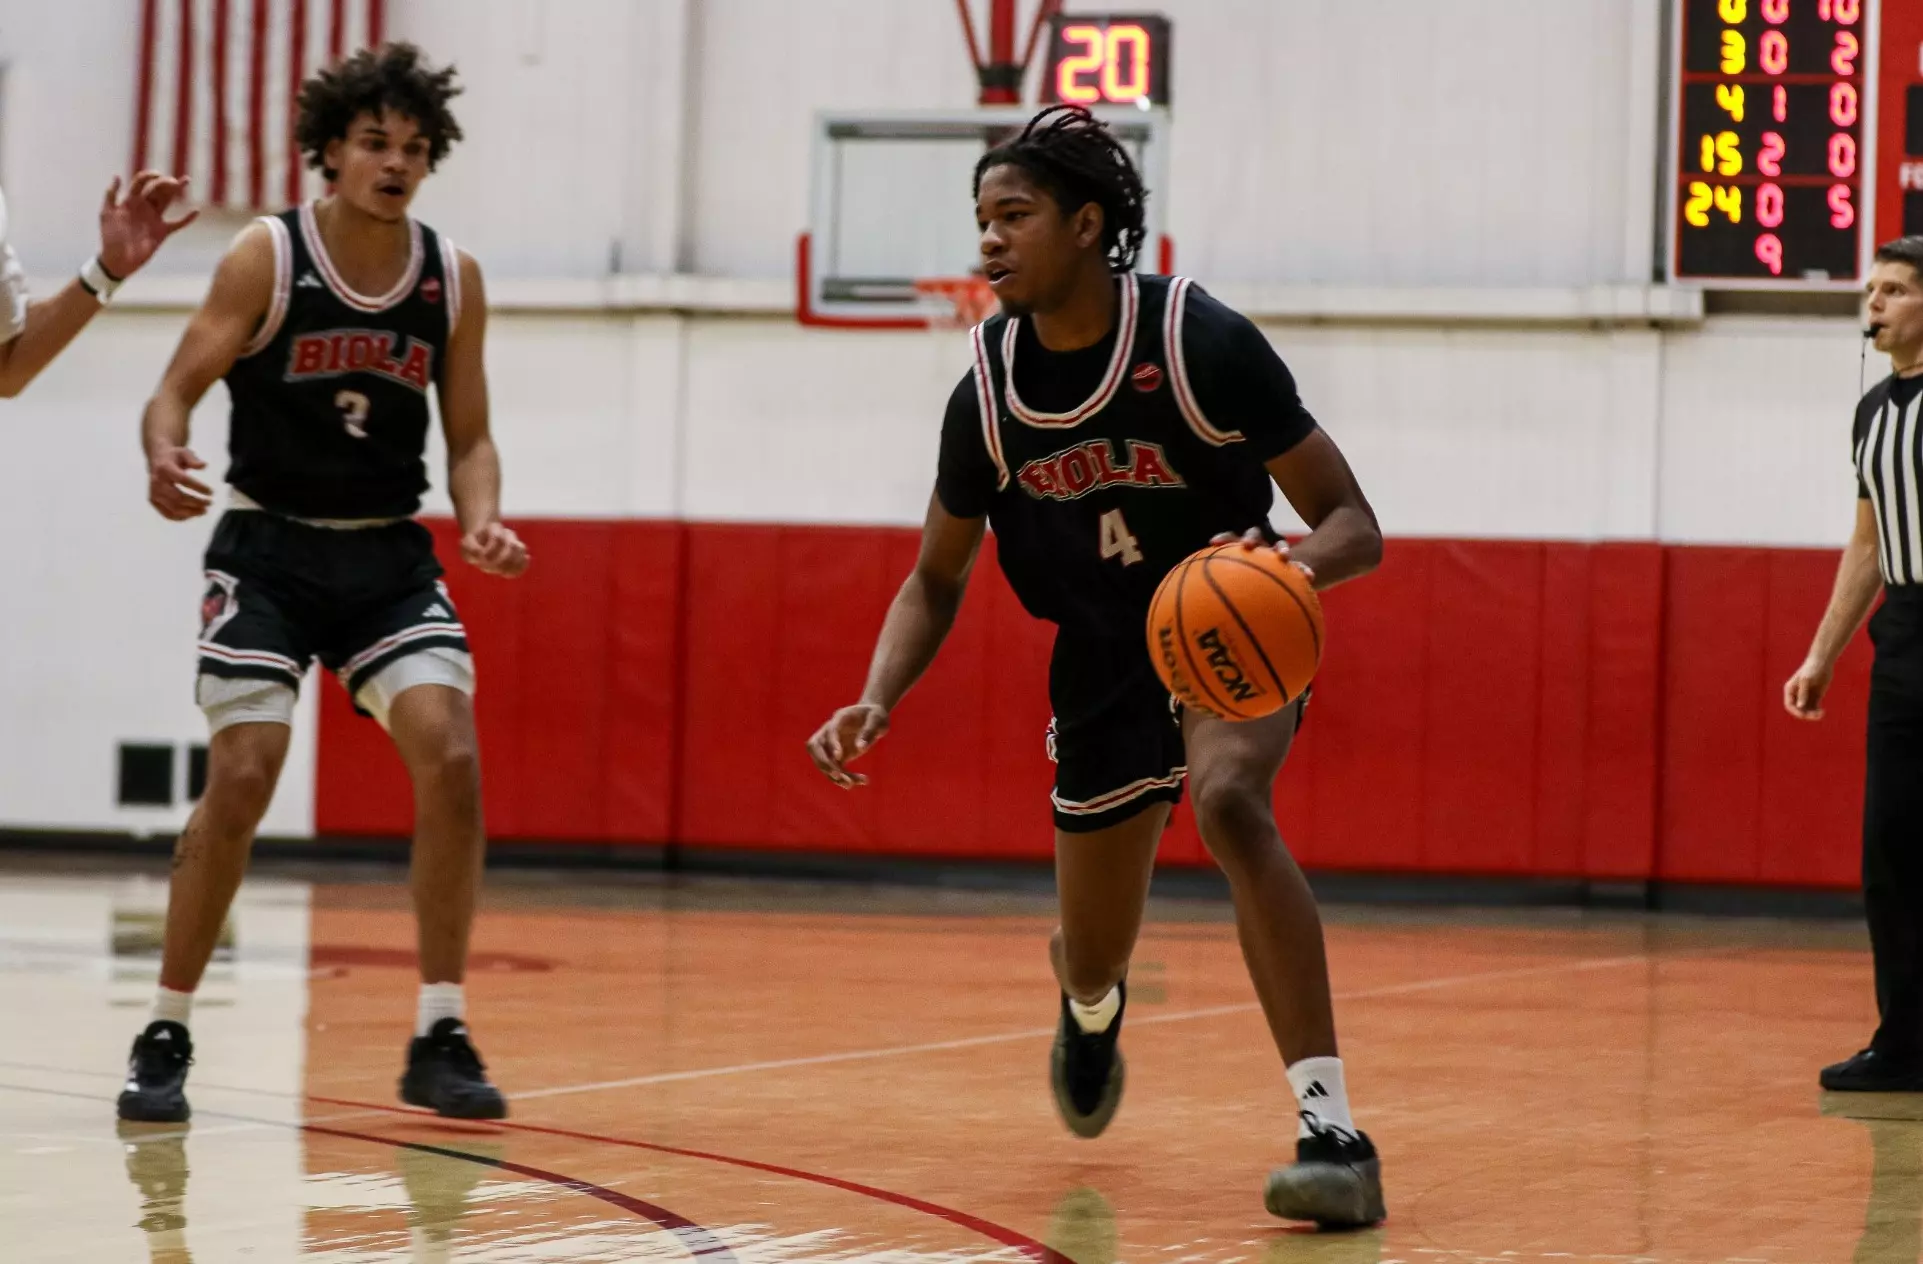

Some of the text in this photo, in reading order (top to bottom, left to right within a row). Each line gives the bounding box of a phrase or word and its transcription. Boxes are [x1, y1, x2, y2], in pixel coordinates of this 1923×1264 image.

[1057, 25, 1150, 105] 20
[1720, 29, 1858, 76] 3 0 2
[1716, 82, 1857, 127] 4 1 0
[1700, 131, 1856, 177] 15 2 0
[1685, 181, 1854, 228] 24 0 5
[1754, 233, 1782, 275] 9
[283, 328, 434, 394] BIOLA
[1099, 507, 1144, 568] 4
[1197, 627, 1259, 703] NCAA
